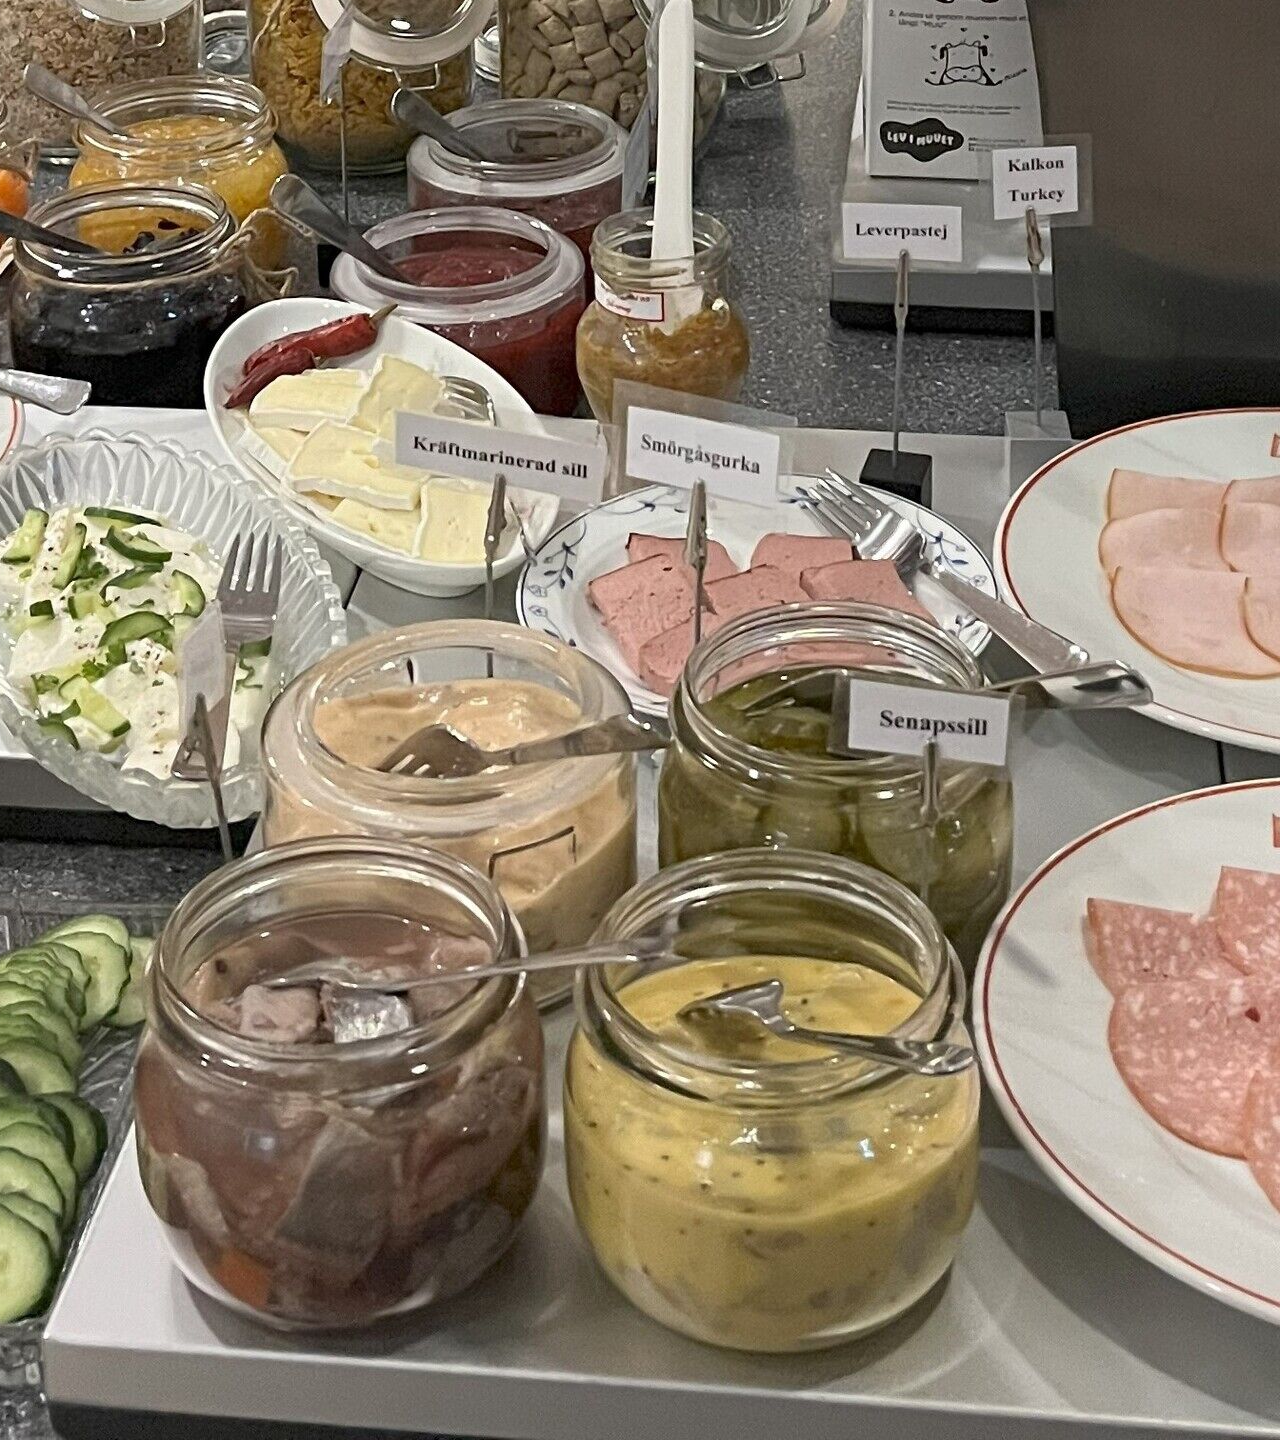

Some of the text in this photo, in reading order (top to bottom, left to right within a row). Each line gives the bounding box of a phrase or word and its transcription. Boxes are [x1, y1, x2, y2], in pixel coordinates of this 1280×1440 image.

[1008, 158, 1065, 173] Kalkon
[1008, 188, 1065, 203] Turkey
[855, 222, 948, 240] Leverpastej
[413, 435, 588, 479] Kräftmarinerad sill
[641, 433, 761, 475] Smörgåsgurka
[880, 709, 988, 737] Senapssill
